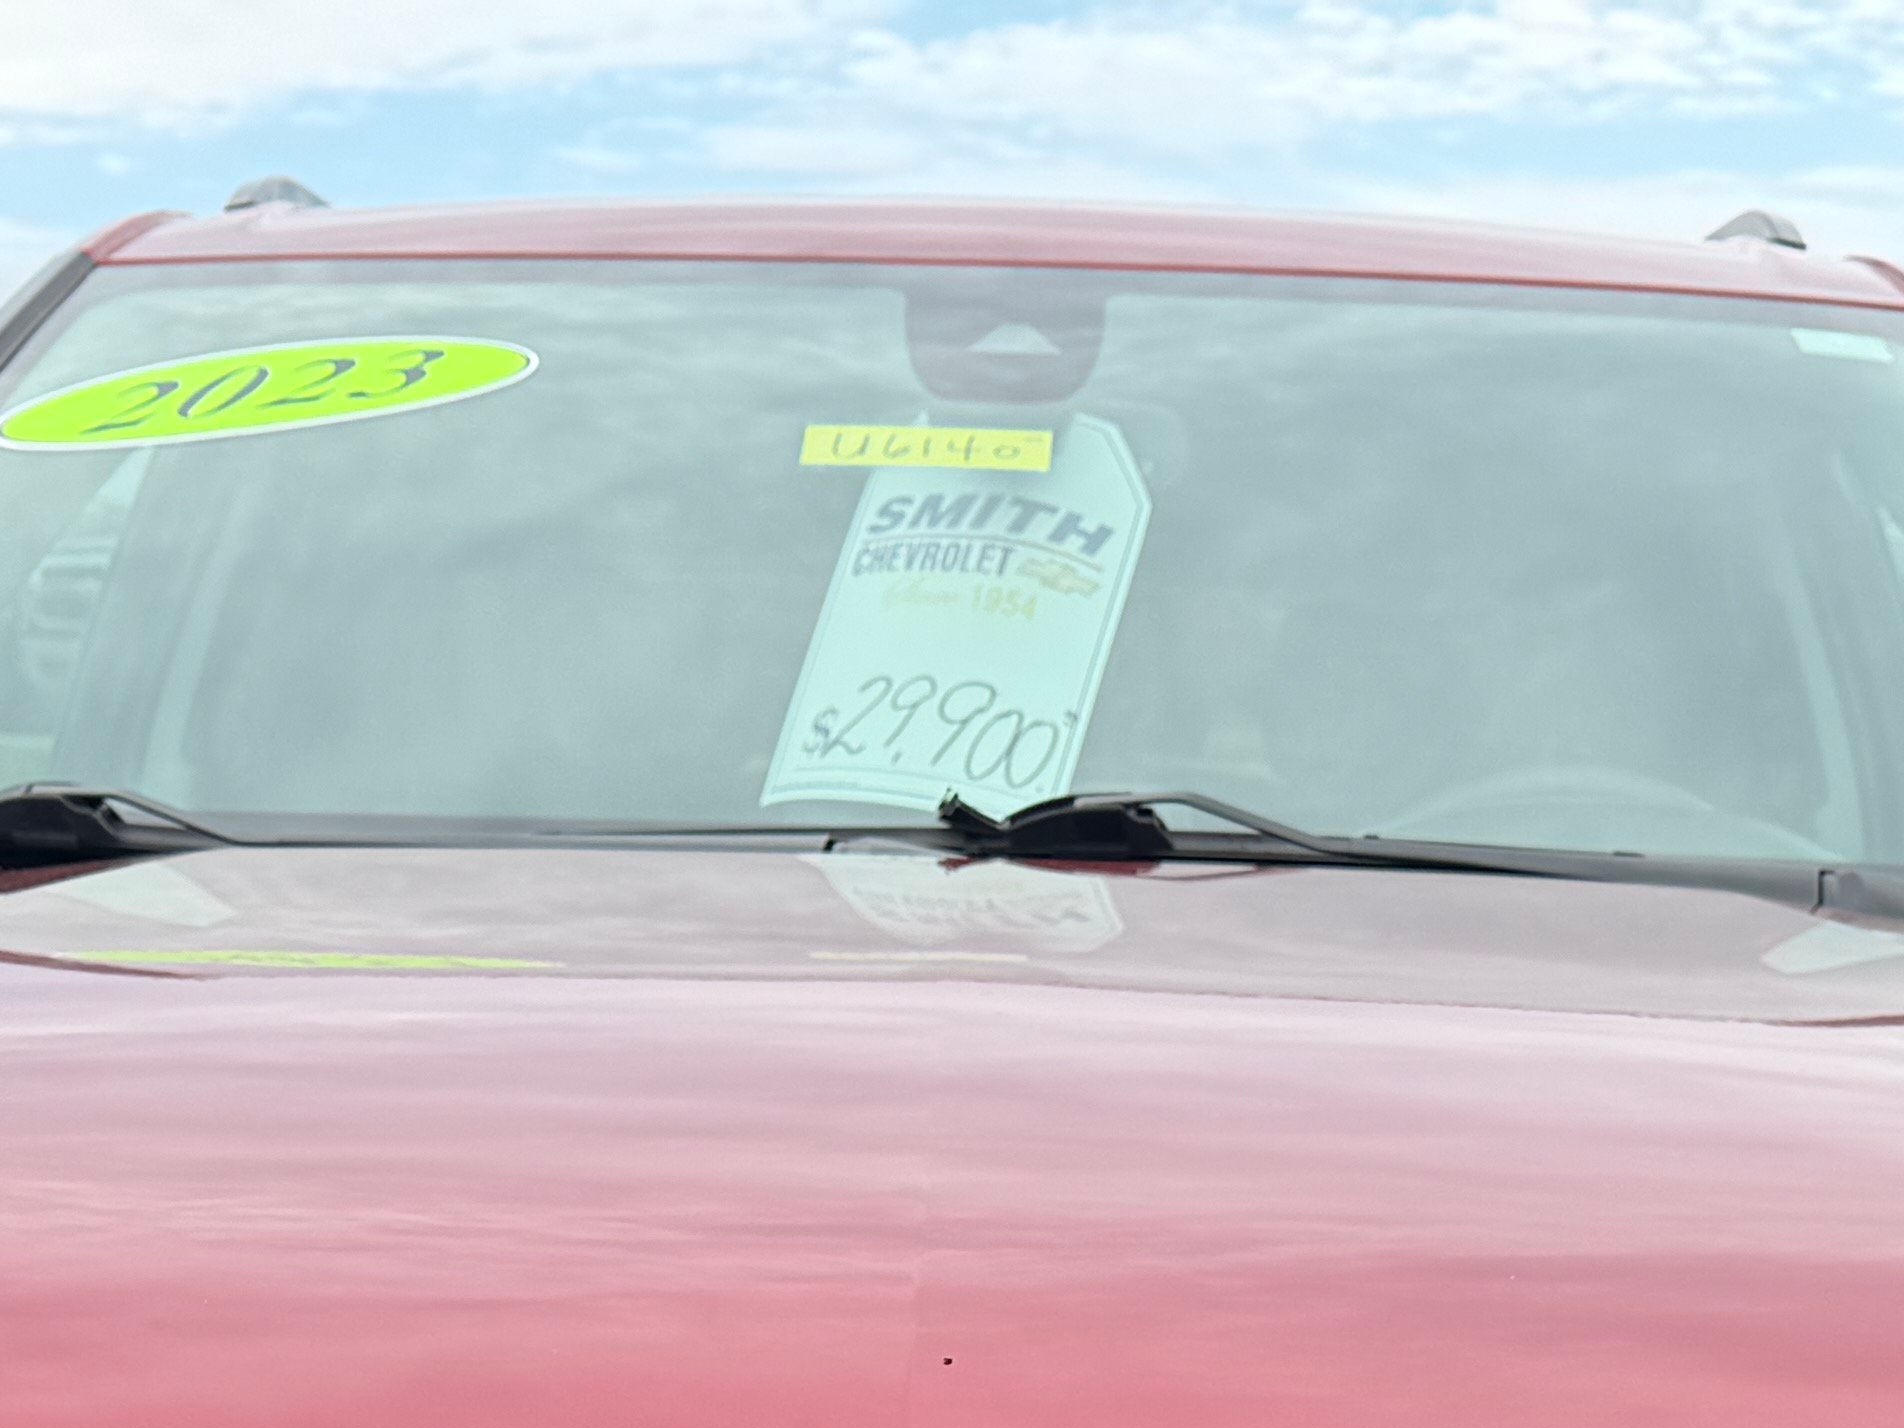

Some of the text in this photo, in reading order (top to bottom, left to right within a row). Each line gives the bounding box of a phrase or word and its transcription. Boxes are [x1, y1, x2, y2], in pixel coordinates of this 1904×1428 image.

[80, 349, 446, 436] 2023
[867, 491, 1114, 557] SMITH
[851, 542, 1015, 577] CHEVROLET
